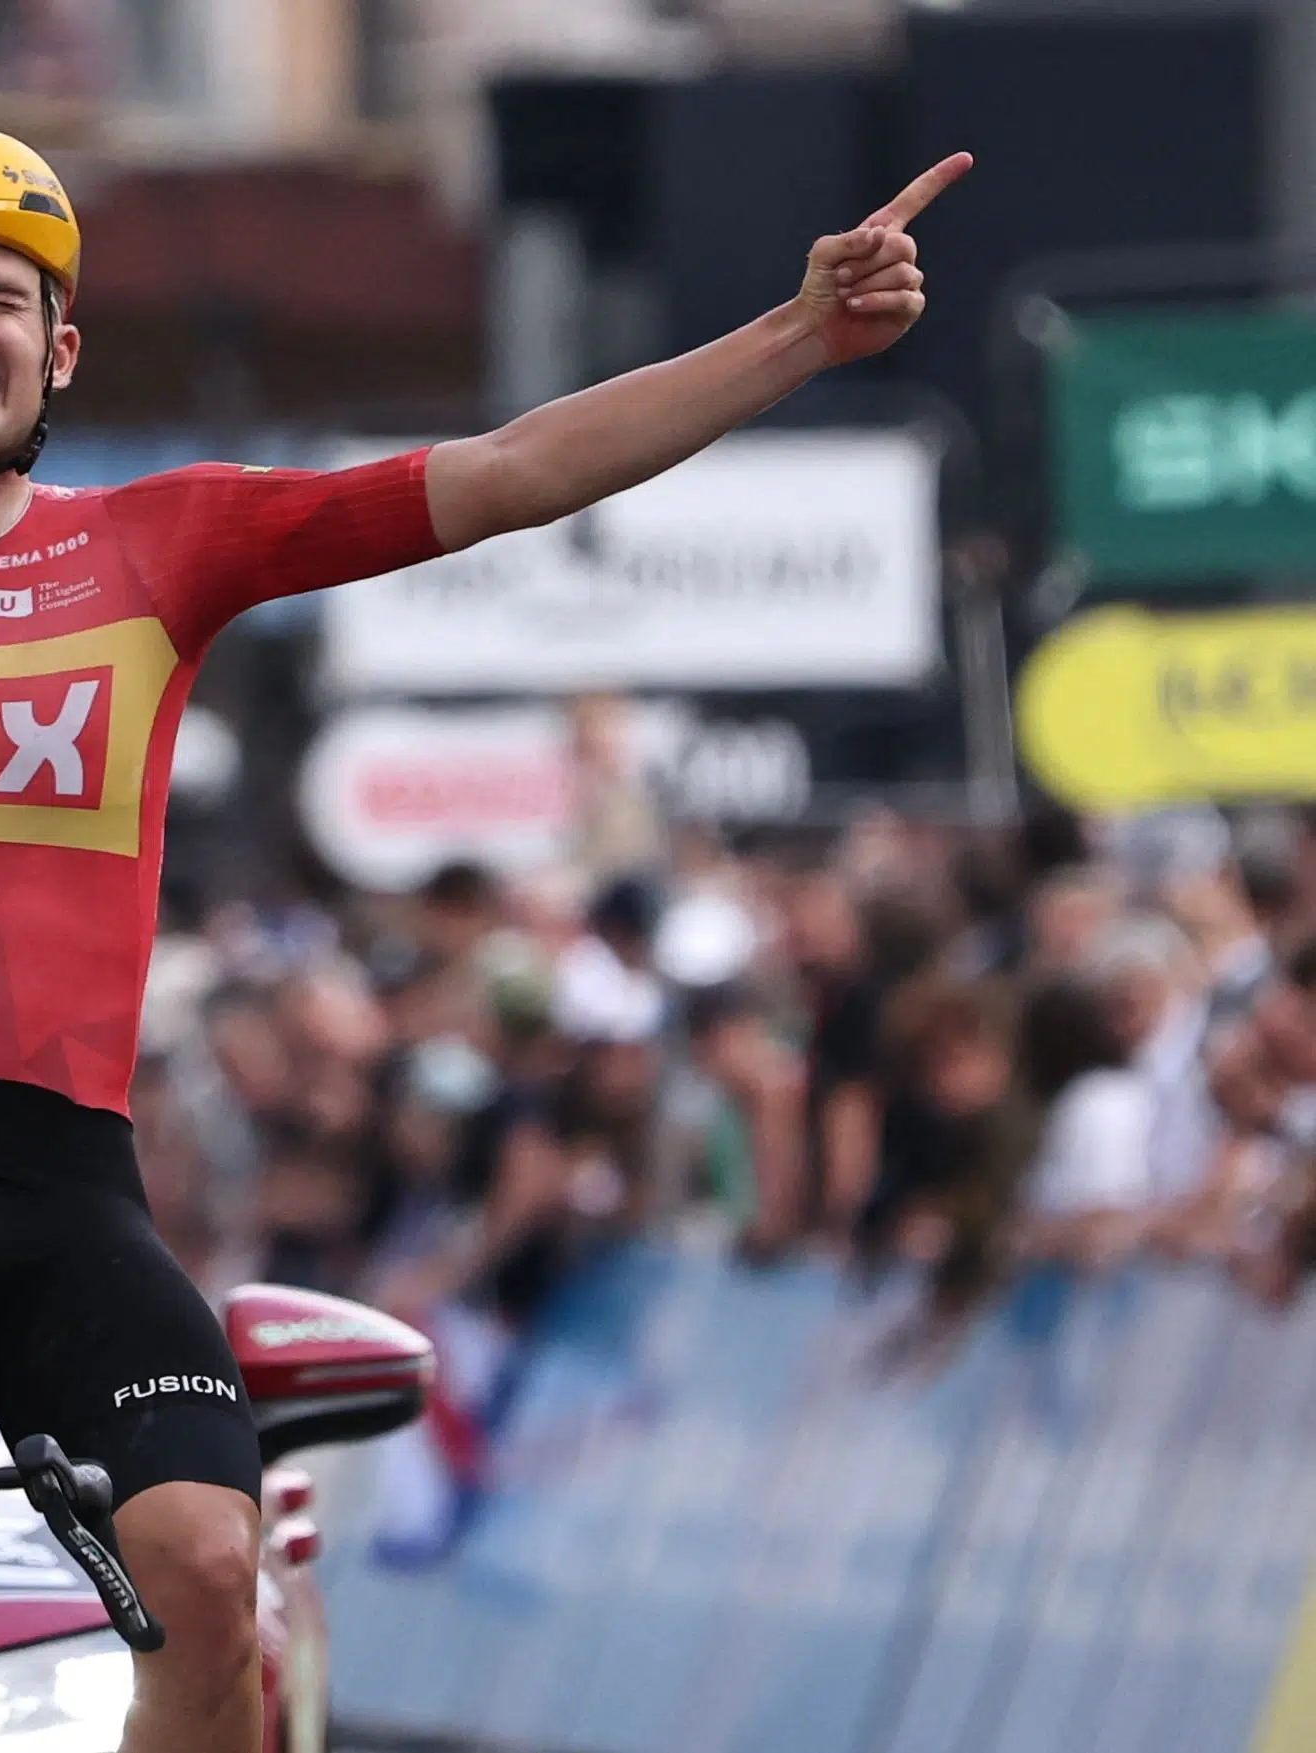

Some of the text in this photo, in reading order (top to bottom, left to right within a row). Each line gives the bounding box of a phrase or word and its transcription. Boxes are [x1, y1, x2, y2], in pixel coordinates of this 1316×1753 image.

[46, 531, 89, 559] 1000
[38, 580, 60, 592] The
[39, 586, 102, 611] Companies
[113, 1374, 237, 1408] FUSION
